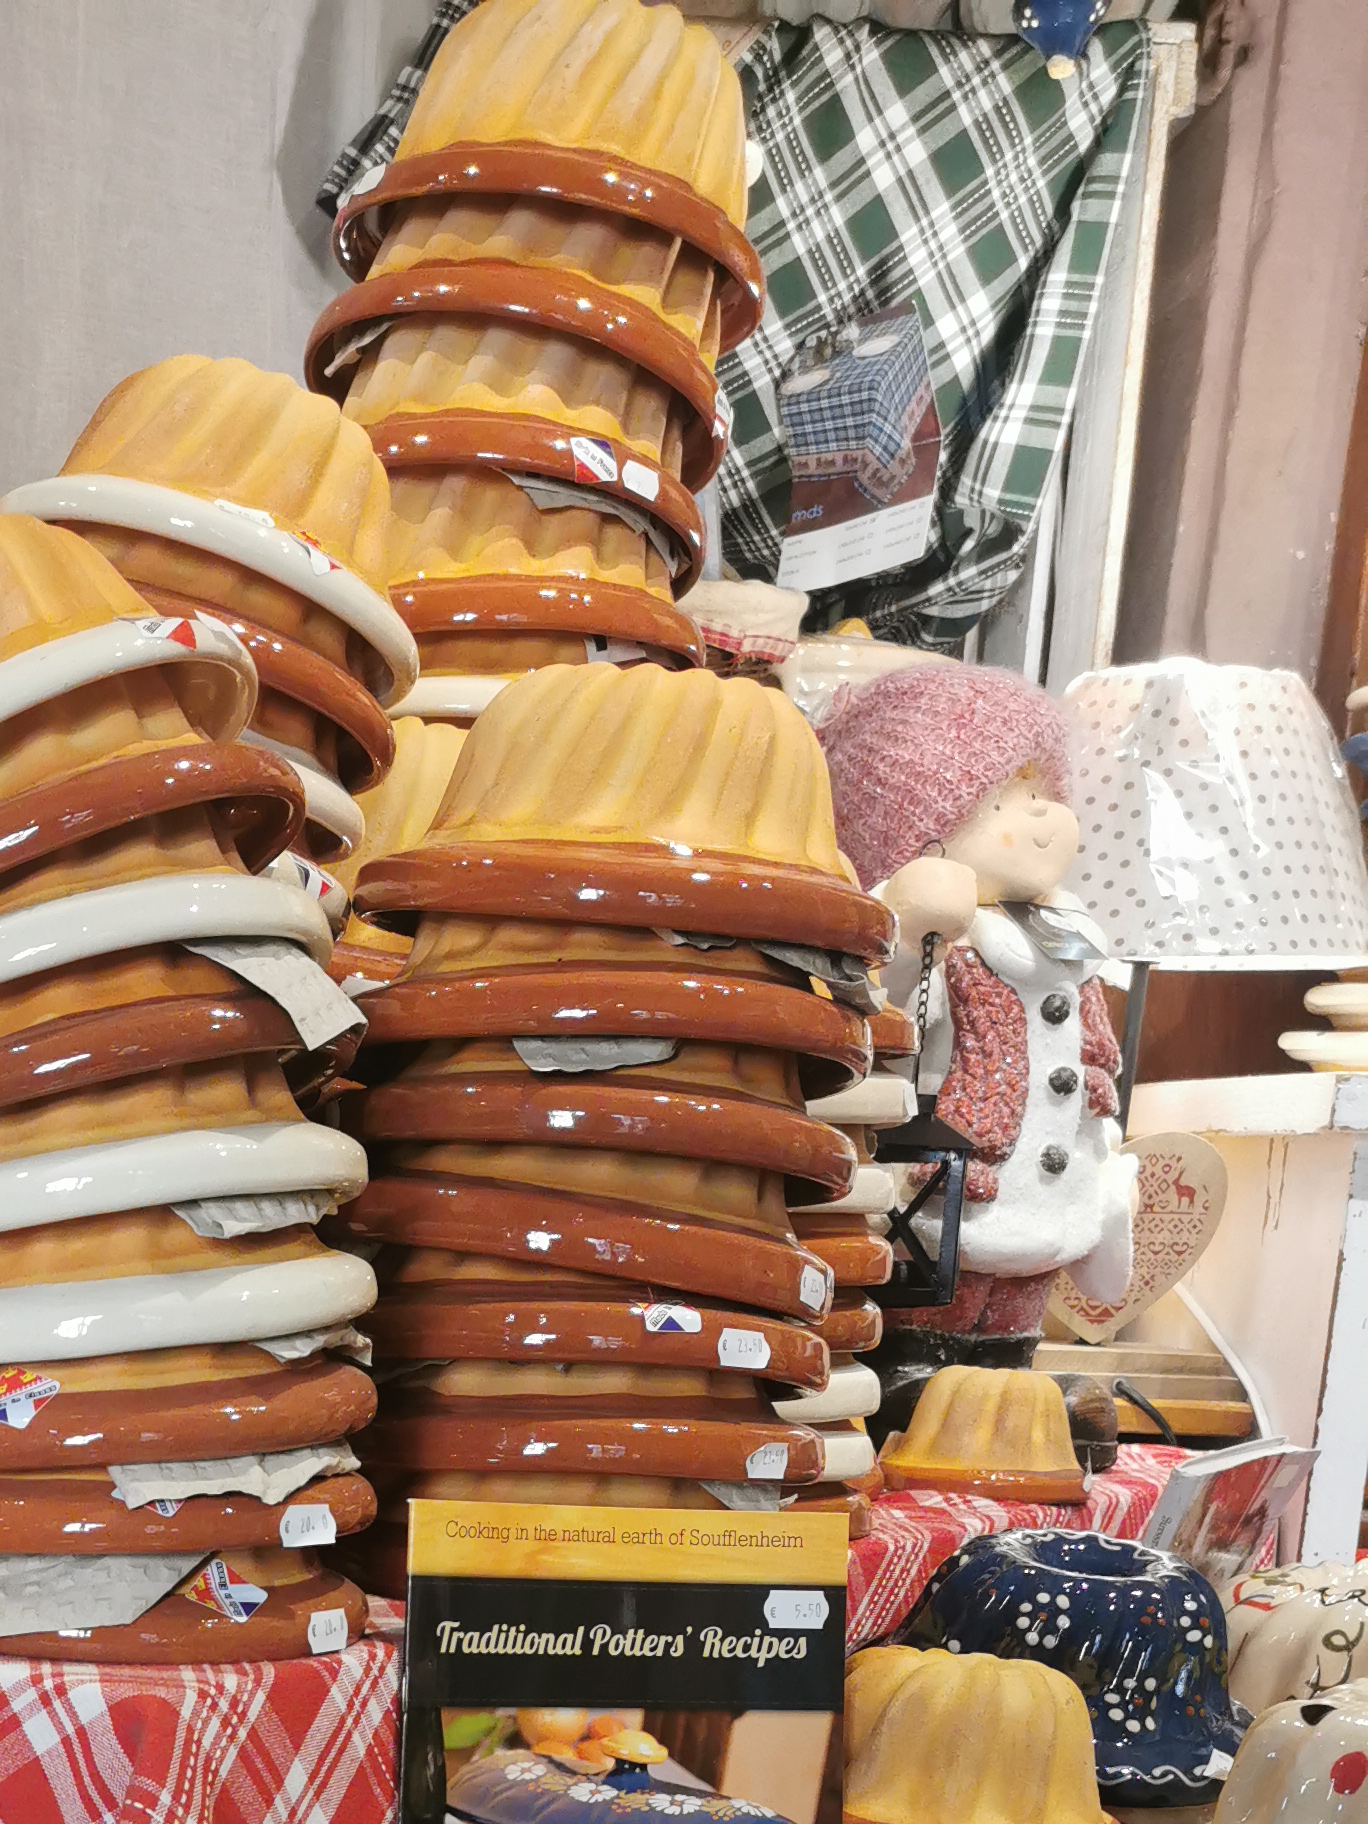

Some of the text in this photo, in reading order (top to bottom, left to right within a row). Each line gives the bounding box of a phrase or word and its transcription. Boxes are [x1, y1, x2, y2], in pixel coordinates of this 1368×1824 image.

[737, 1338, 763, 1353] 23.50
[445, 1519, 804, 1549] Cooking in the natural earth of Soufflenheim
[769, 1602, 822, 1619] € 5.50
[436, 1620, 808, 1668] Traditional Potters' Recipes
